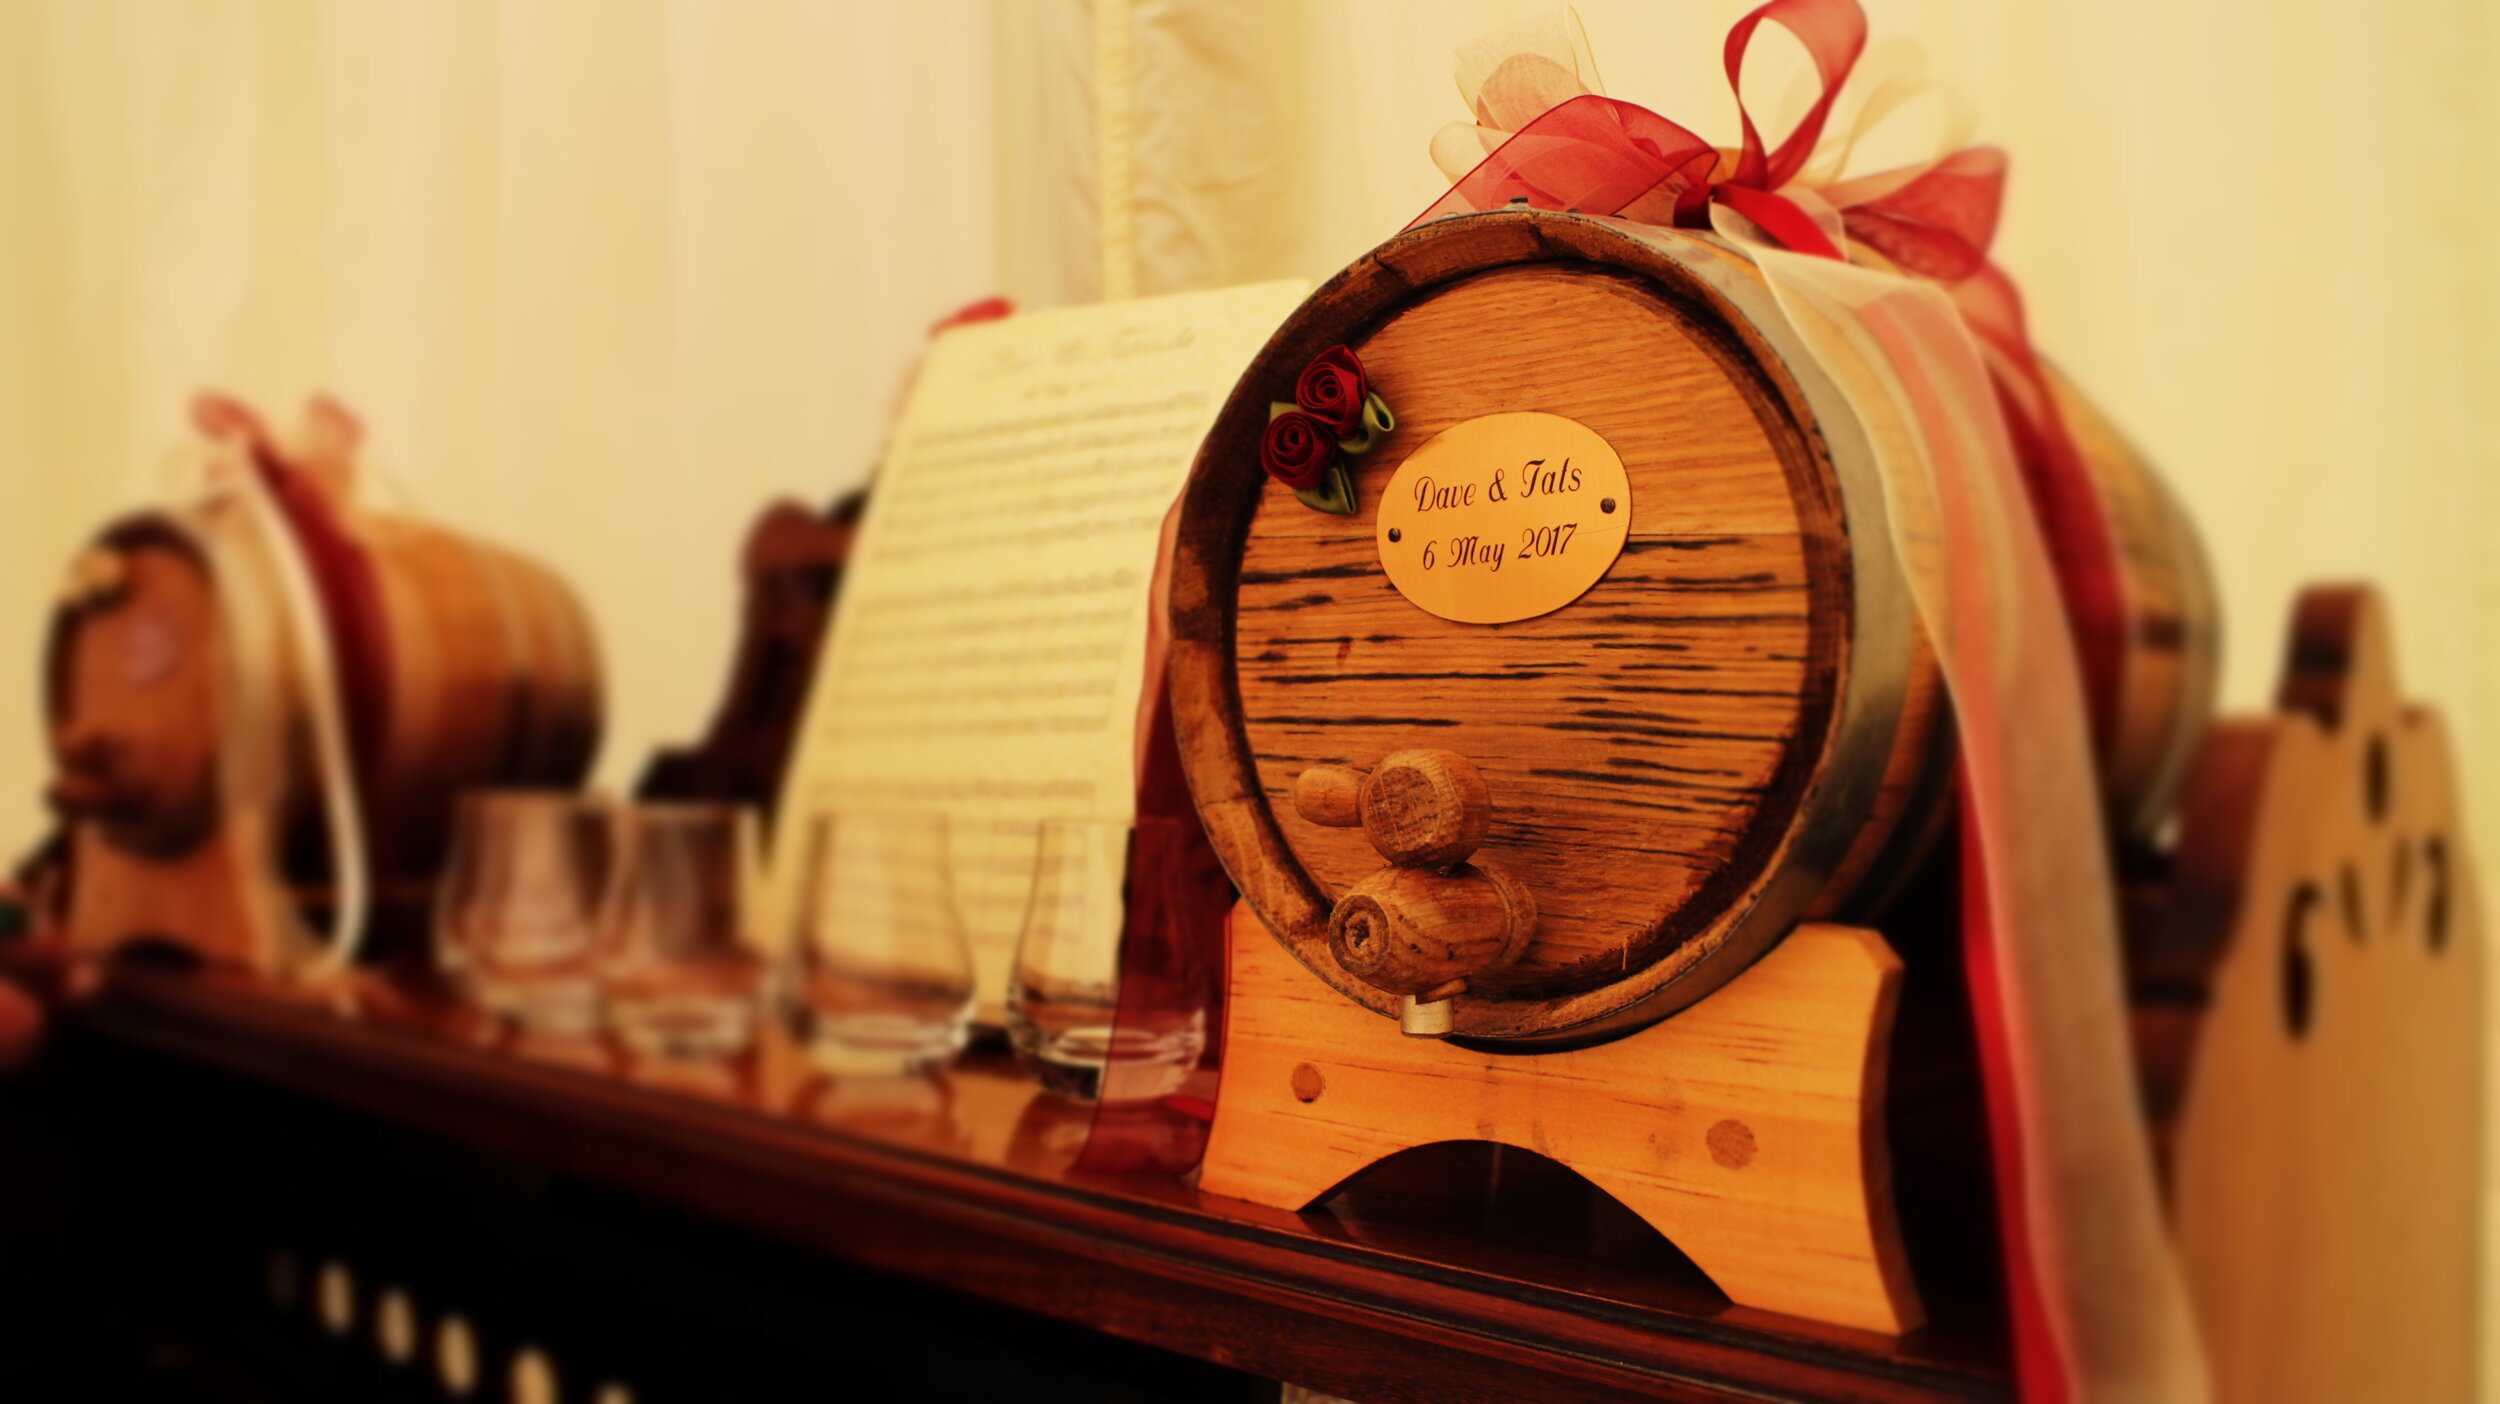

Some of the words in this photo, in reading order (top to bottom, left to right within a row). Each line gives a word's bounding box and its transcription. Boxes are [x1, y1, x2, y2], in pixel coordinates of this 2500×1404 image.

[1414, 476, 1477, 512] Dave
[1488, 468, 1508, 502] &
[1422, 540, 1437, 571] 6
[1447, 534, 1505, 572] May
[1517, 523, 1578, 560] 2017
